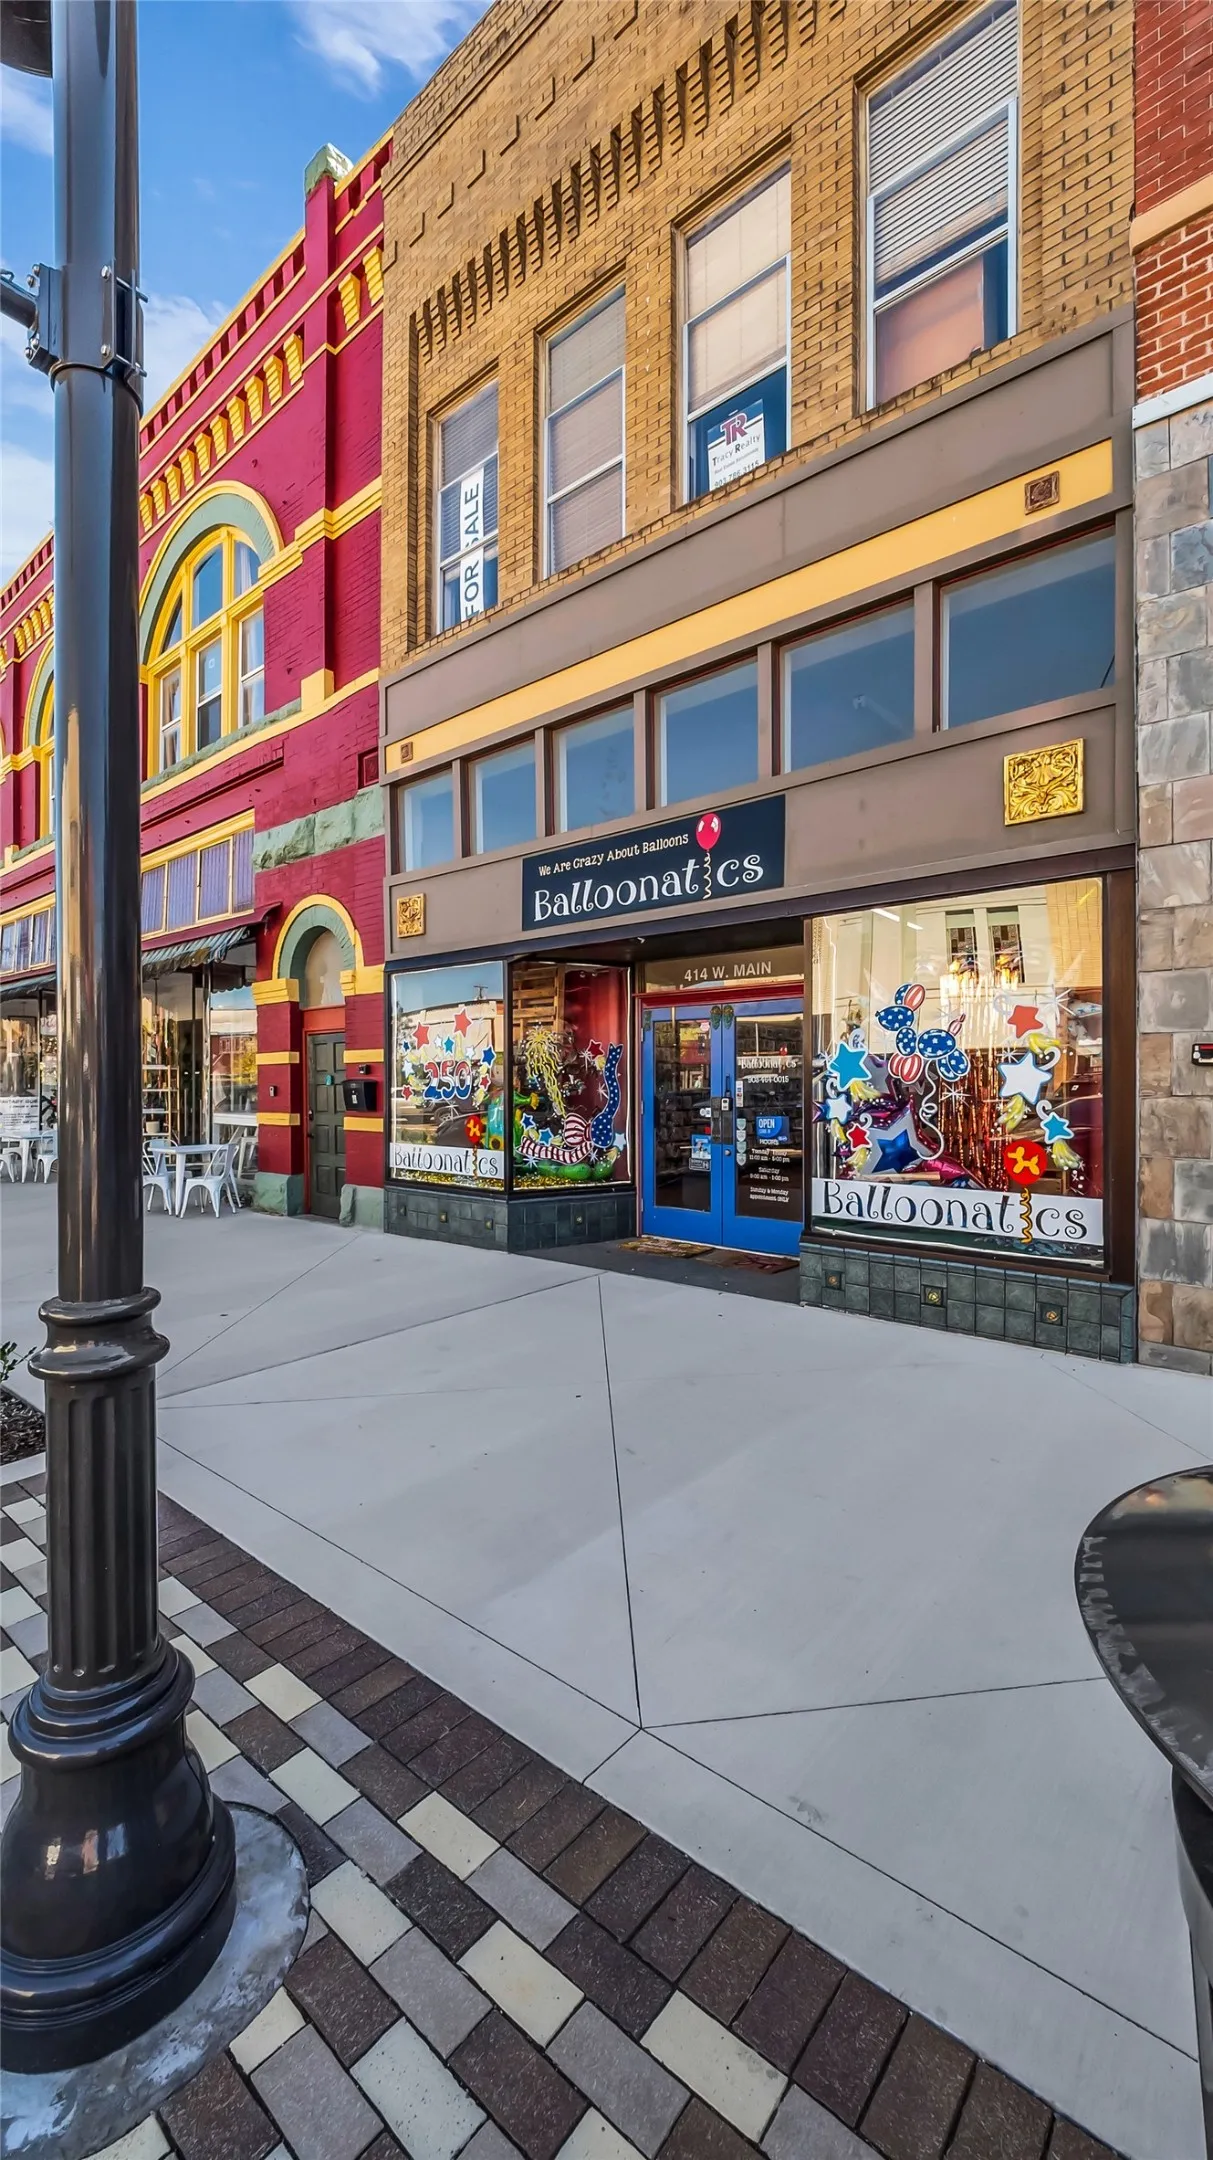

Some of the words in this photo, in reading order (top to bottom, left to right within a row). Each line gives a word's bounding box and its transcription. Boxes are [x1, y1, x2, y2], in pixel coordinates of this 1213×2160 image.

[720, 413, 748, 446] TR
[712, 449, 734, 466] Tracy
[735, 434, 760, 453] Realty
[464, 559, 480, 619] FOR
[539, 865, 551, 877] We
[553, 861, 571, 874] Are
[573, 854, 604, 870] Crazy
[607, 844, 639, 862] About
[642, 833, 689, 854] Balloons
[684, 967, 708, 982] 414
[712, 965, 729, 979] W.
[734, 961, 772, 977] MAIN
[423, 1060, 471, 1100] 250
[758, 1118, 775, 1129] OPEN
